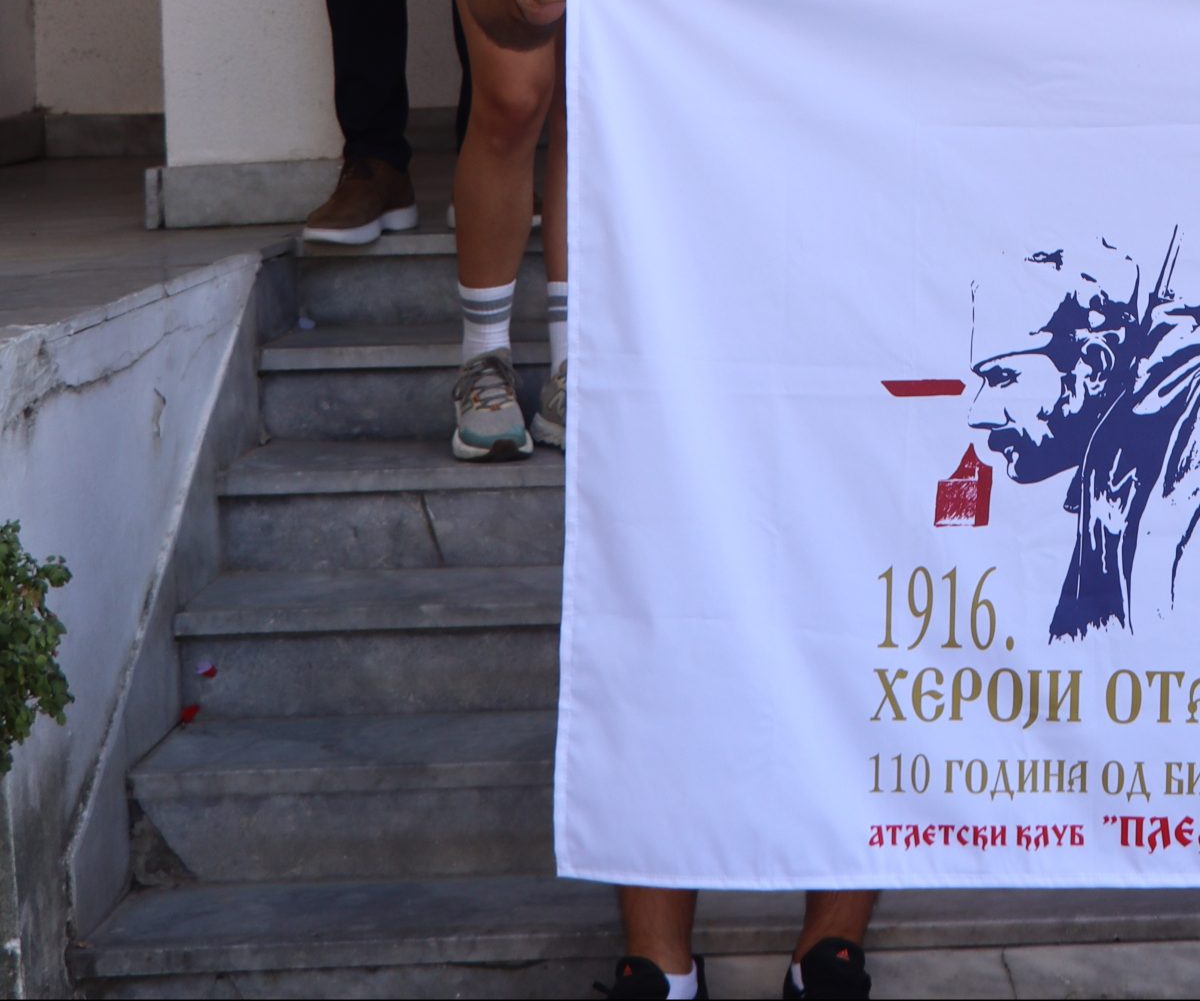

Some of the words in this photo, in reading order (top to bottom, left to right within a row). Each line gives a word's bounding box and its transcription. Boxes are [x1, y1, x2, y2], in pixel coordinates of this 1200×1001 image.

[876, 565, 1015, 652] 1916.
[870, 667, 1083, 730] ХЕРОЈИ
[868, 752, 931, 794] 110
[943, 758, 1089, 801] ГОДИНА
[1101, 759, 1152, 803] ОД
